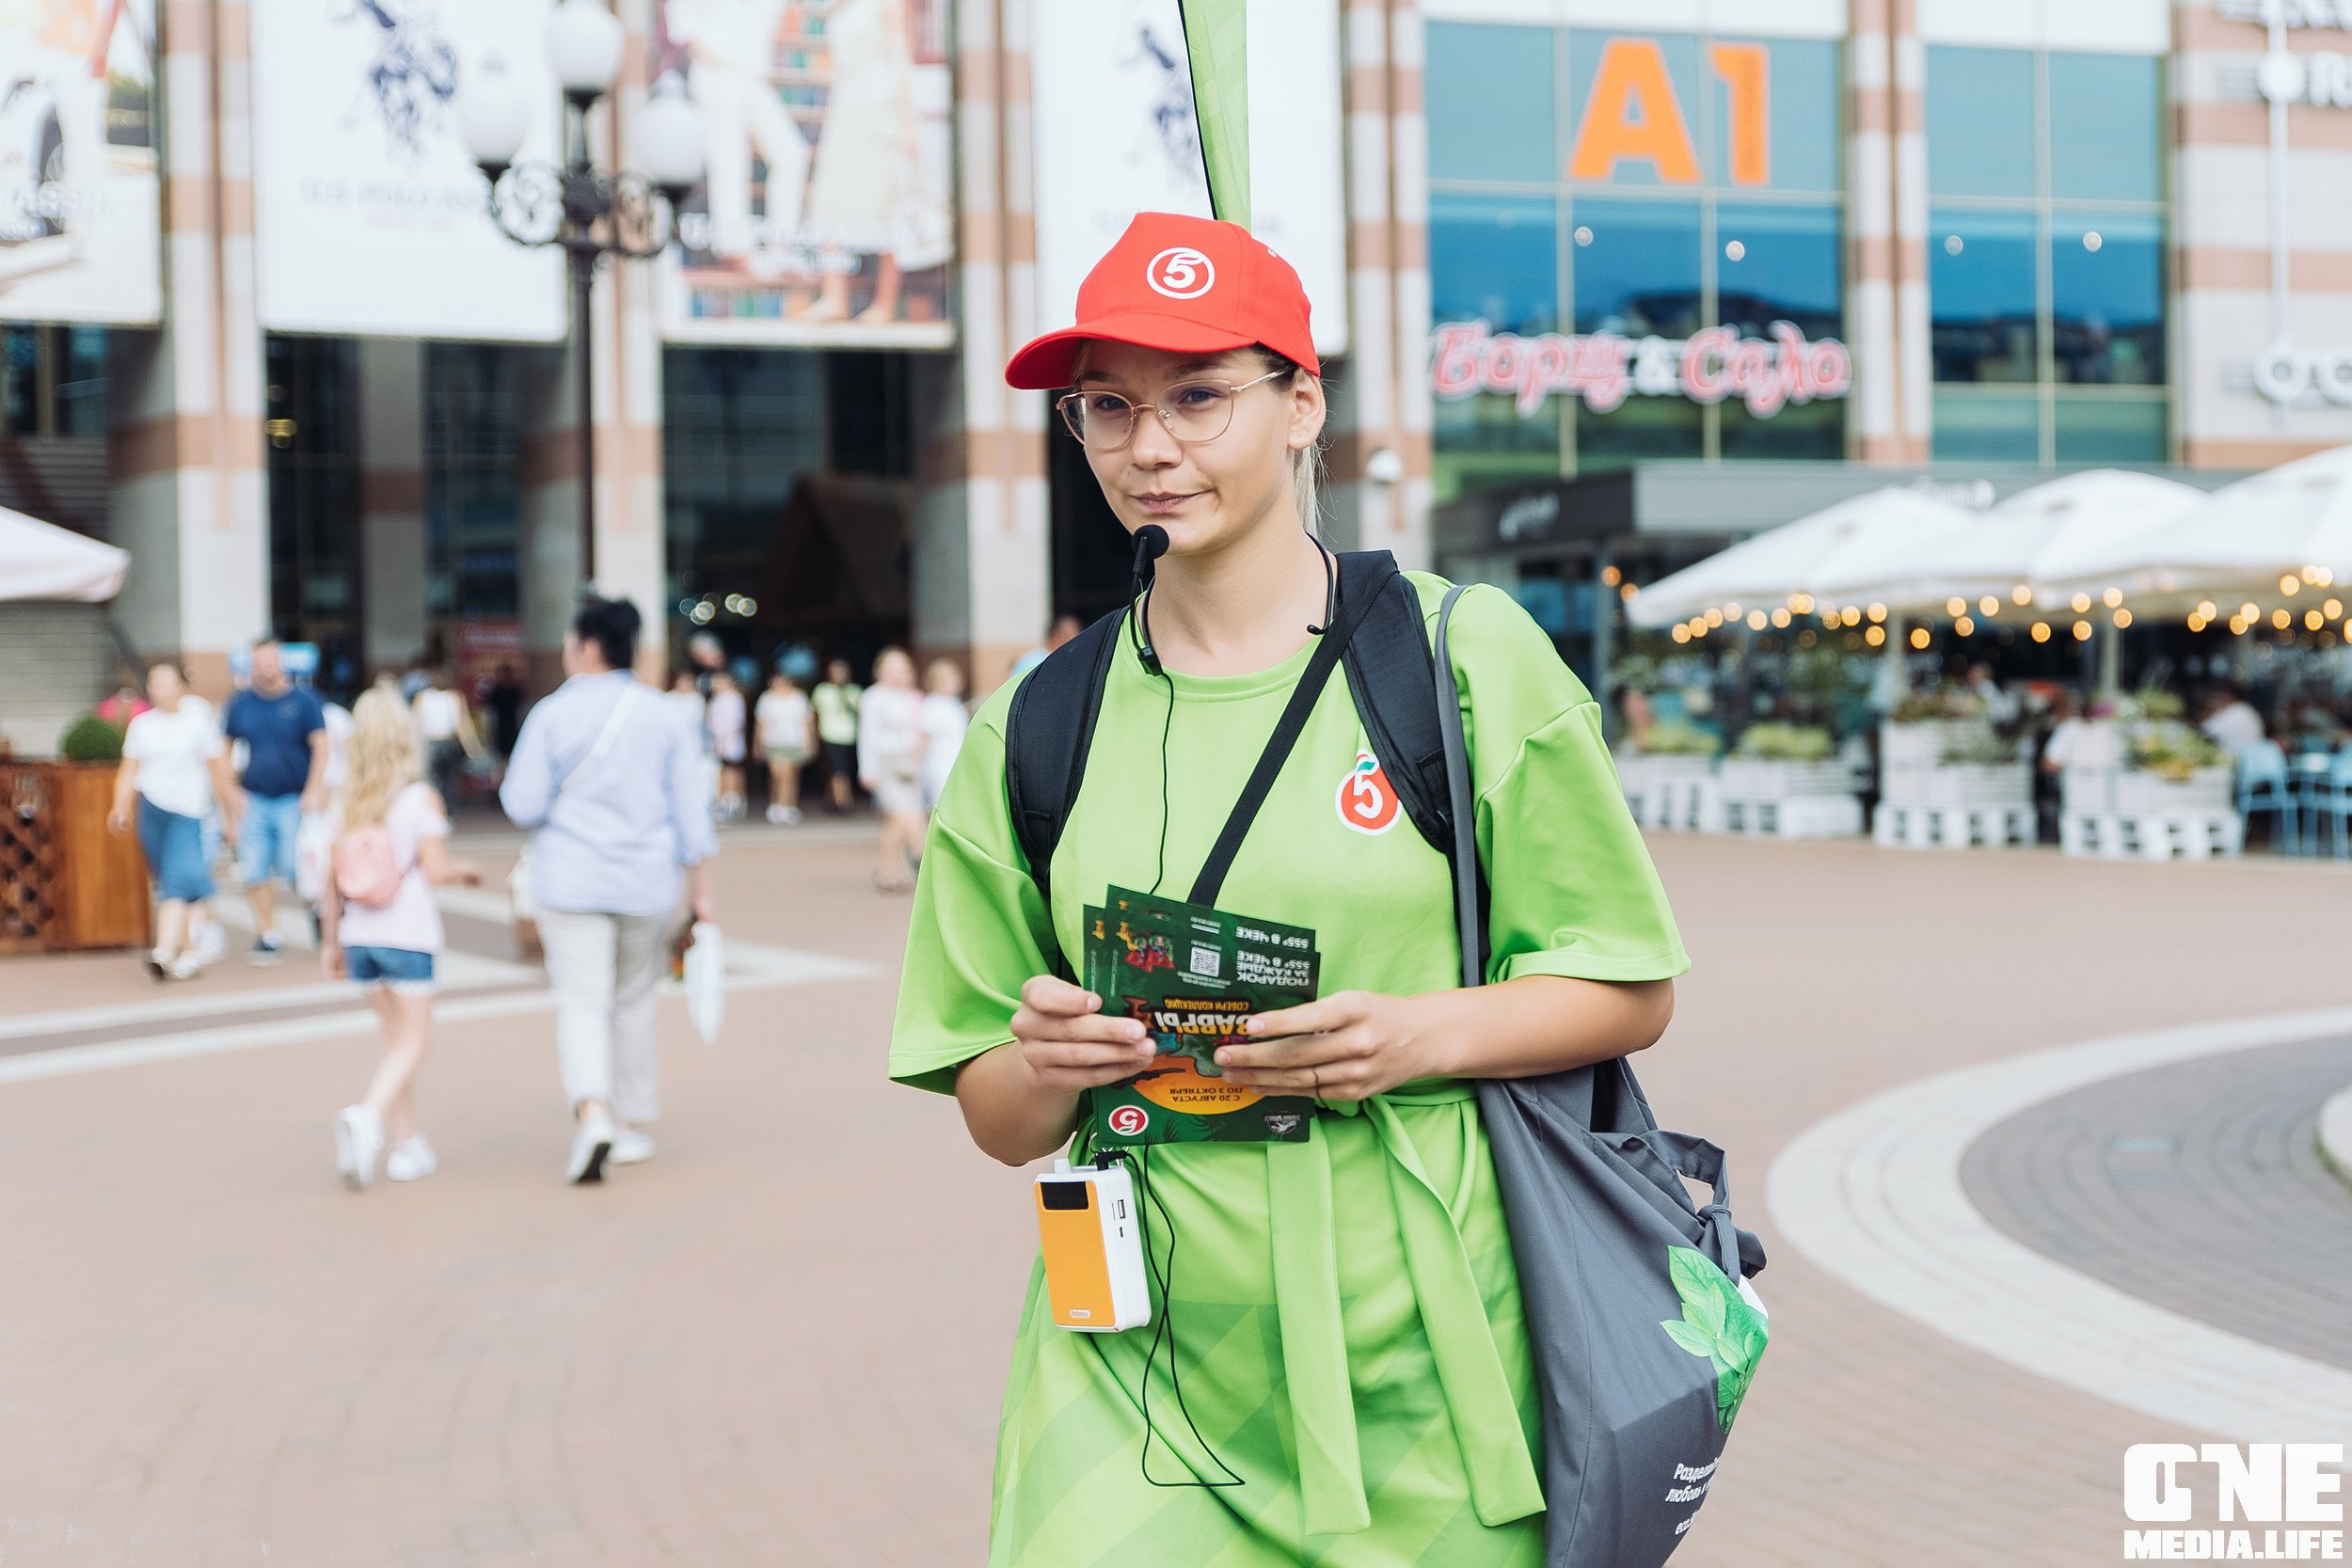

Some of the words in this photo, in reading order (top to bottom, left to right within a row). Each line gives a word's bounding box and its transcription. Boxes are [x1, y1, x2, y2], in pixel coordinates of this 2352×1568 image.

[1680, 320, 1851, 419] Сало
[1235, 926, 1270, 943] ЧЕКЕ
[1237, 950, 1271, 966] ЧЕКЕ
[1235, 960, 1293, 976] КАЖДЫЕ
[1236, 971, 1310, 987] ПОДАРОК
[1164, 998, 1214, 1011] КОЛЛЕКЦИЮ
[1215, 1000, 1249, 1012] СОБЕРИ
[1169, 1086, 1216, 1095] ОКТЯБРЯ
[1171, 1094, 1216, 1102] АВГУСТА
[1218, 1094, 1231, 1102] 20
